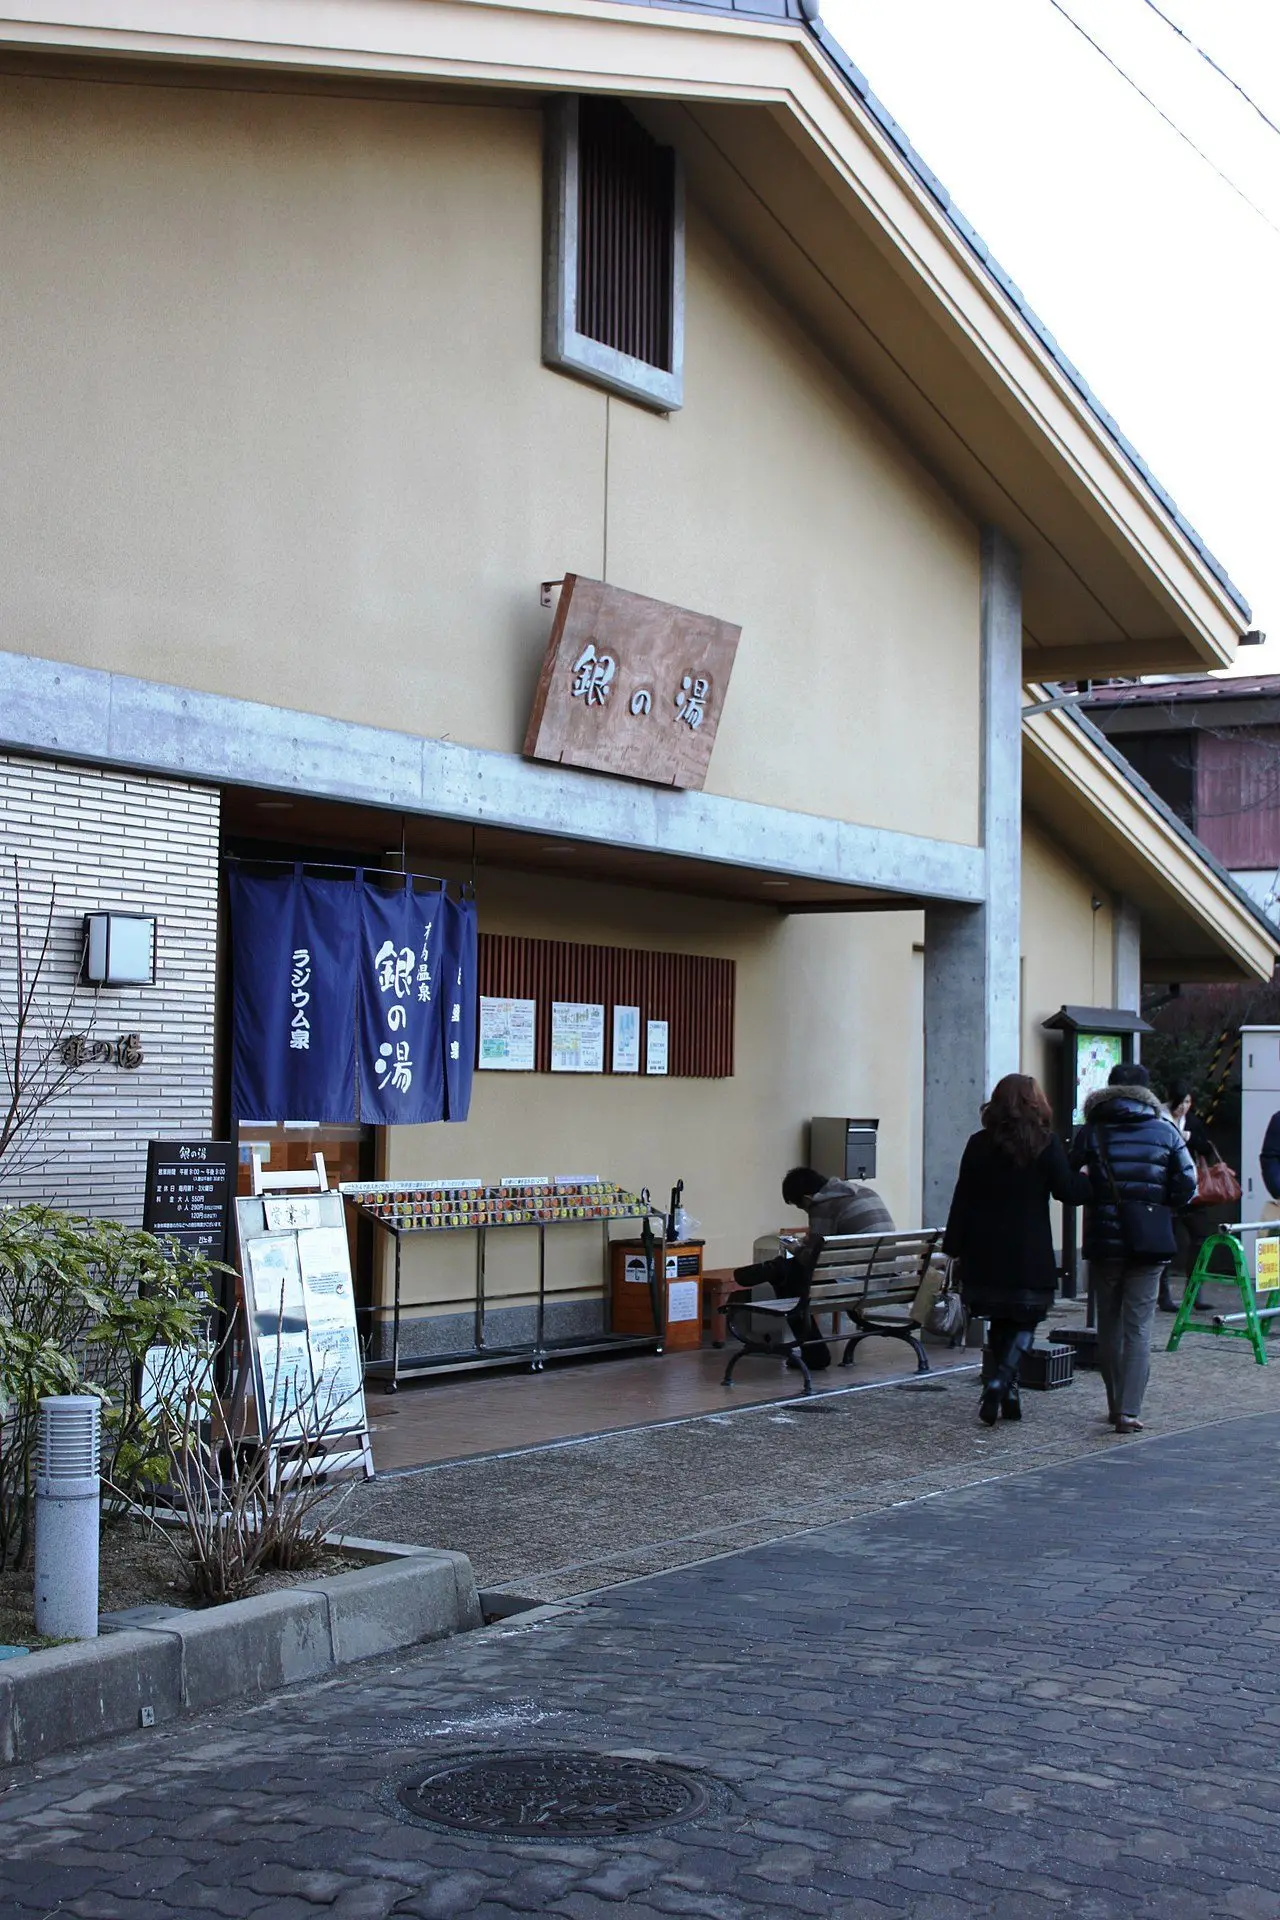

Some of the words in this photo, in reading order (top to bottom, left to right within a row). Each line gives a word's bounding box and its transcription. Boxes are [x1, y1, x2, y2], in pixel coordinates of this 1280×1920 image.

[571, 643, 709, 730] 銀の湯
[289, 949, 311, 1050] ラジウム泉
[375, 940, 416, 1094] 銀の湯
[62, 1033, 144, 1069] 銀の湯
[179, 1145, 207, 1160] 銀の湯
[271, 1203, 312, 1227] 営業中
